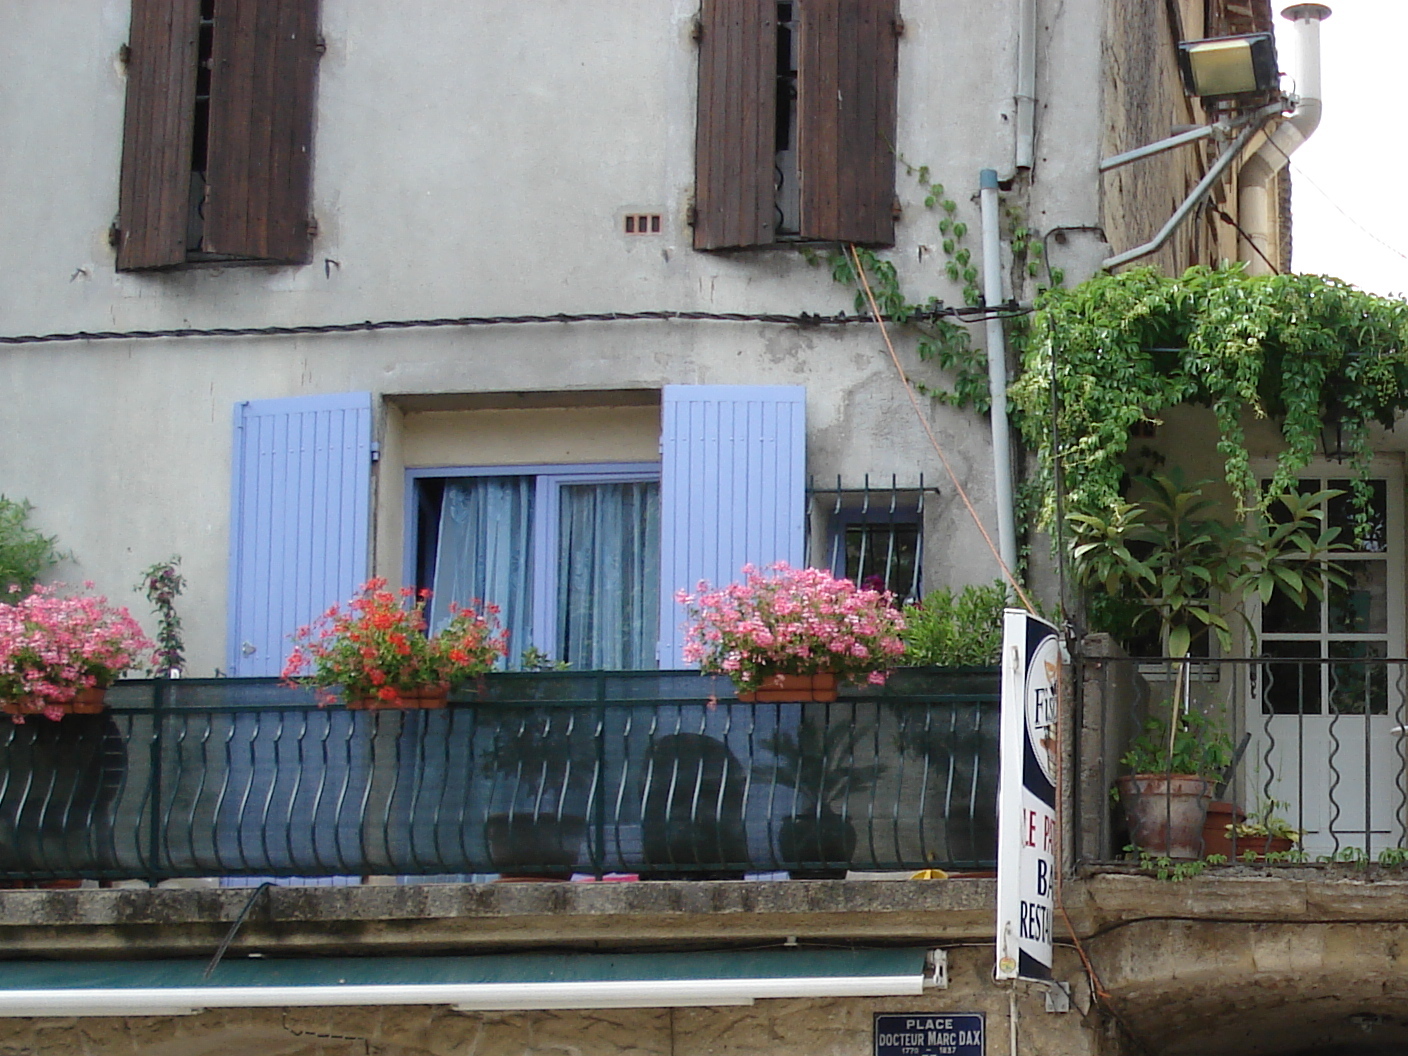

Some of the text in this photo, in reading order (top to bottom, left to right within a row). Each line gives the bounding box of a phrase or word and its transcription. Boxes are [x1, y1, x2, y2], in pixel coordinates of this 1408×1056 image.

[906, 1019, 954, 1030] PLACE
[879, 1033, 925, 1046] DOCTEUR
[959, 1030, 981, 1046] DAX
